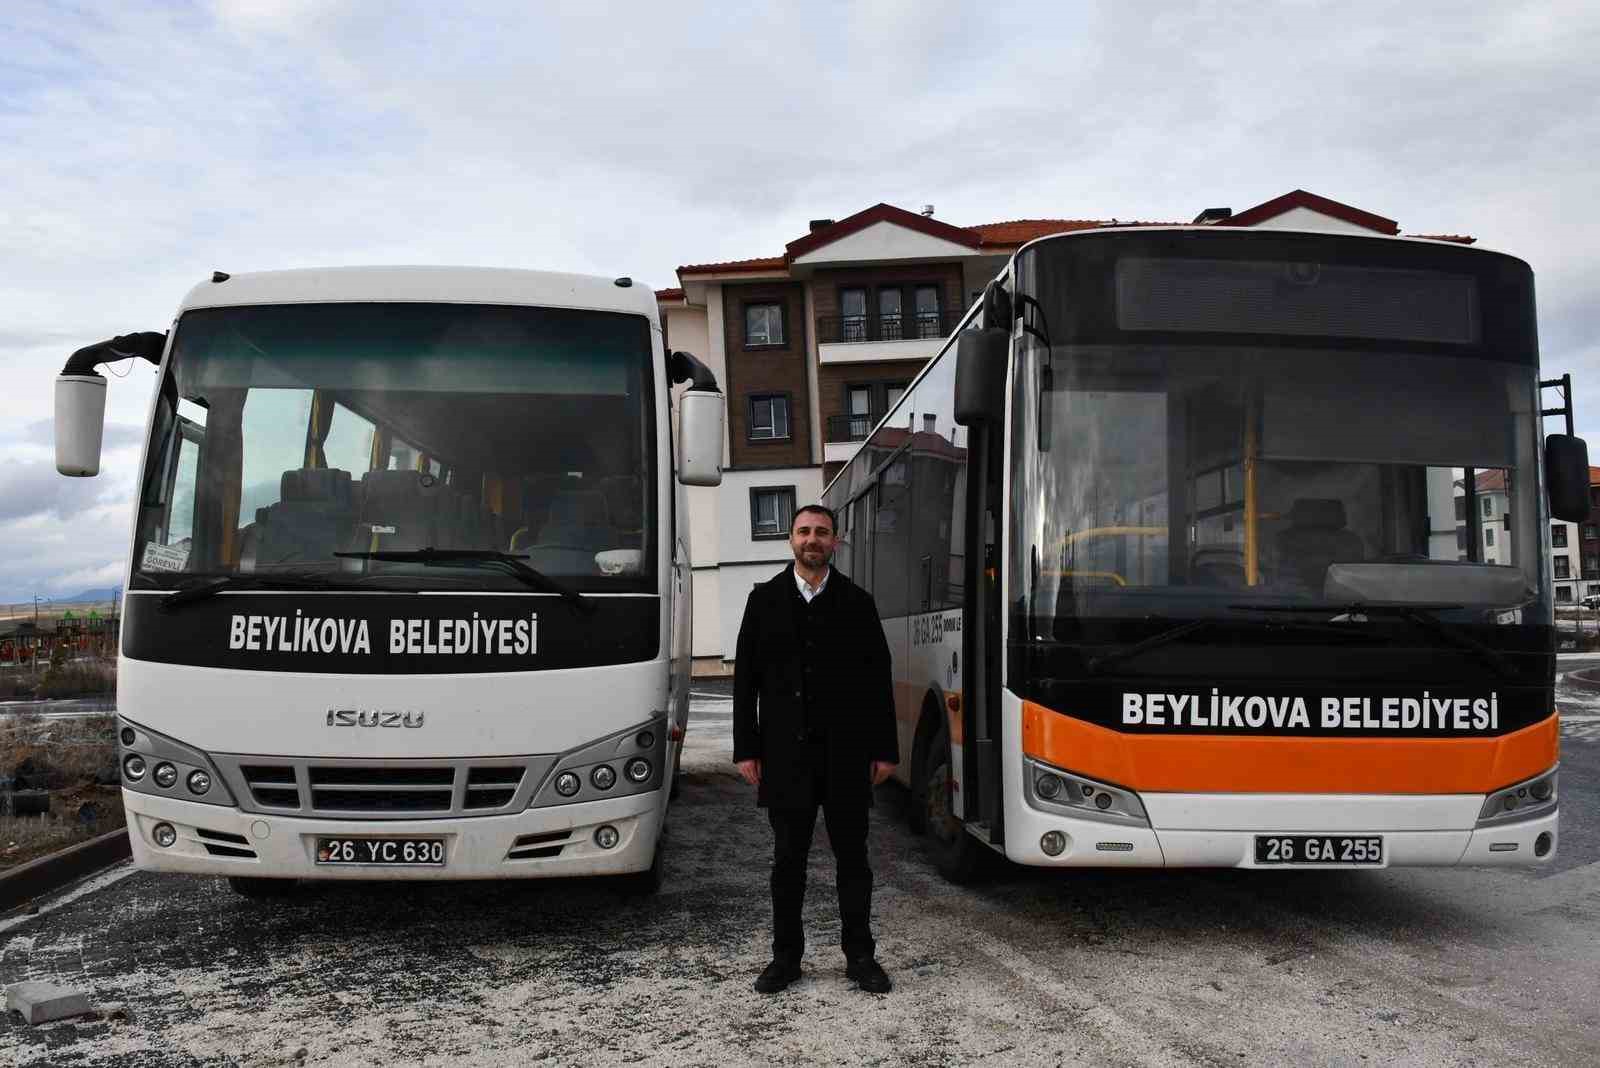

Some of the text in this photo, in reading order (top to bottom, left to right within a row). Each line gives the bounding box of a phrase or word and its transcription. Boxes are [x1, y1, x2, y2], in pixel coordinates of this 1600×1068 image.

[229, 609, 538, 655] BEYLİKOVA BELEDİYESİ
[326, 710, 425, 729] ISUZU
[1122, 688, 1498, 729] BEYLİKOVA BELEDİYESİ
[328, 841, 443, 862] 26 YC 630
[1266, 838, 1381, 860] 26 GA 255
